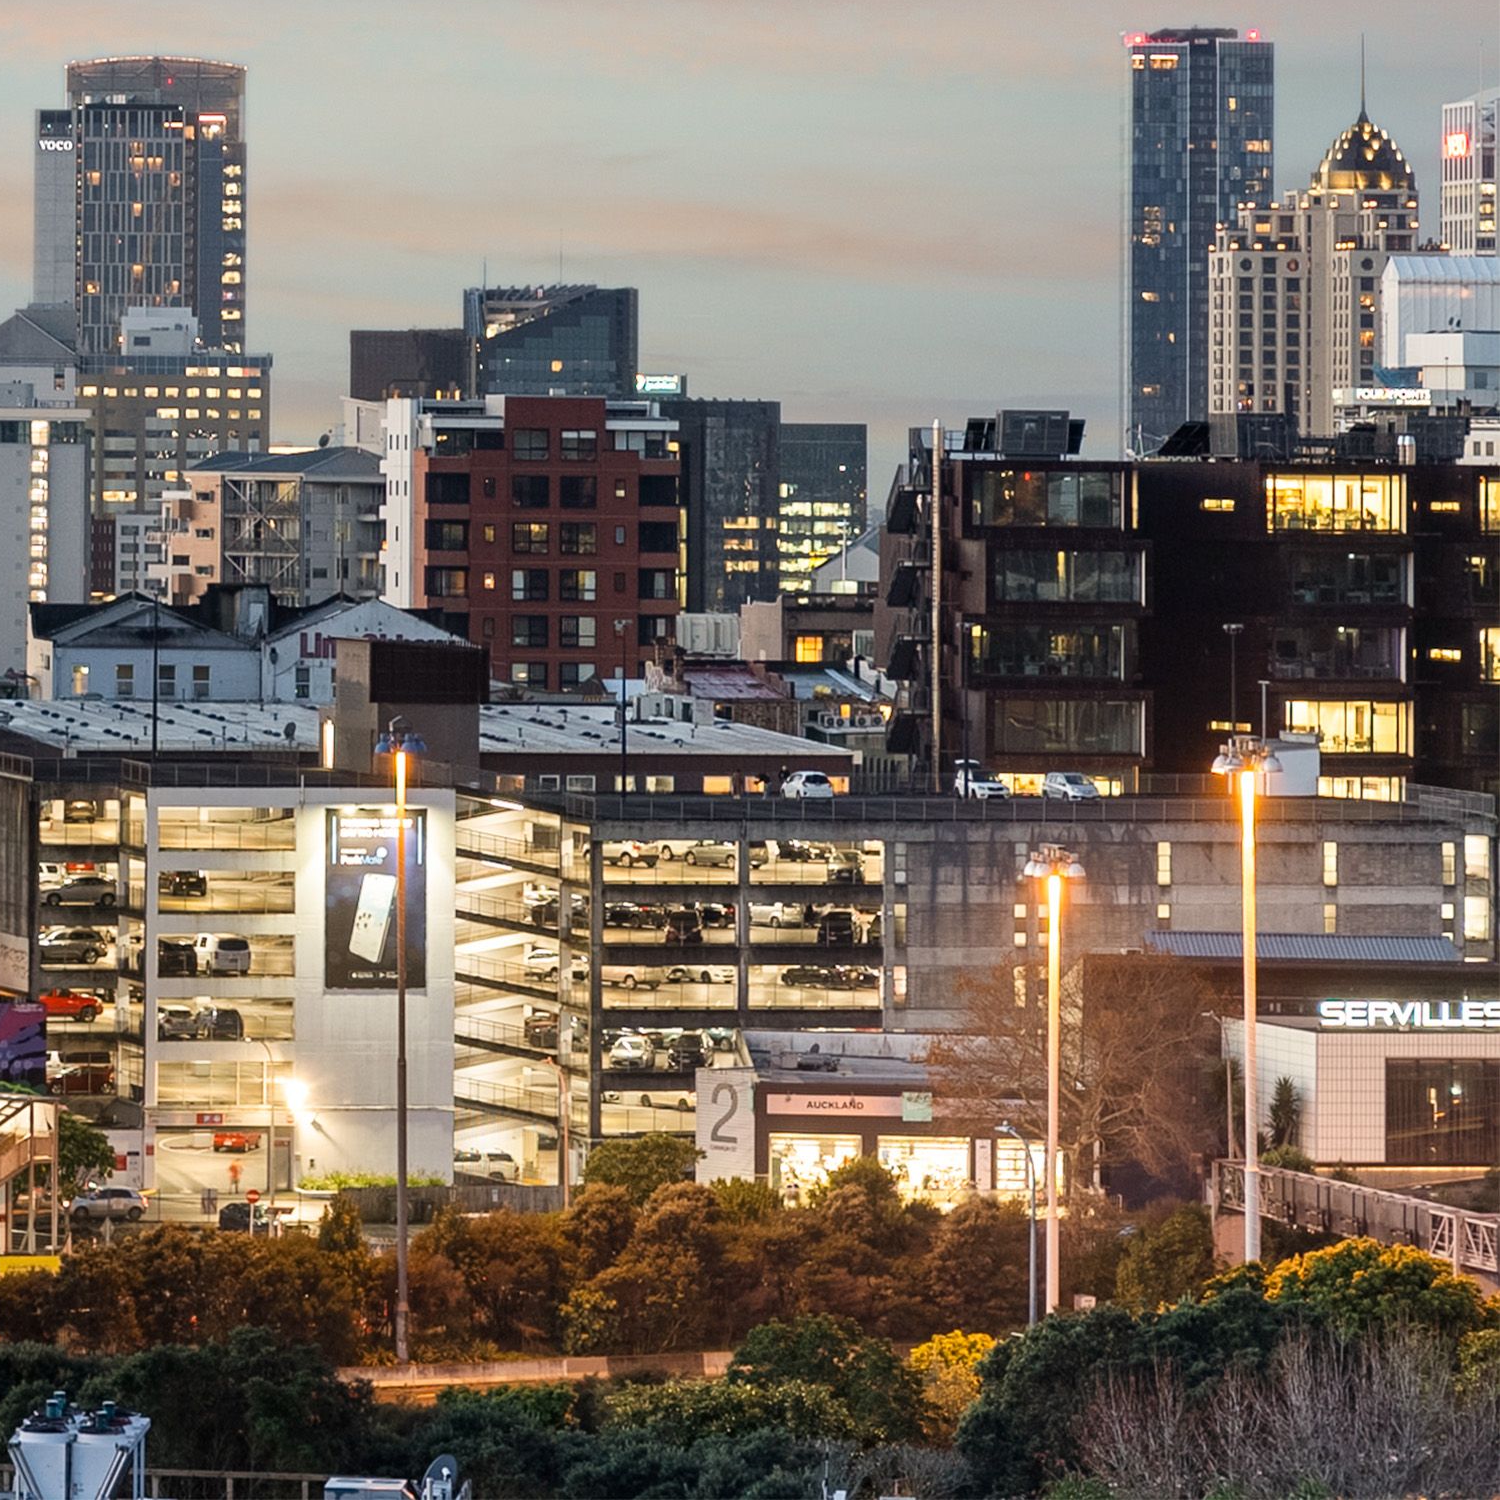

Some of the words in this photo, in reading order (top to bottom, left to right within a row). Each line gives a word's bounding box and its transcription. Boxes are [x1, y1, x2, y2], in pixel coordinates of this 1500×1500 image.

[1320, 1001, 1500, 1027] SERVILLES
[711, 1083, 739, 1144] 2
[806, 1100, 864, 1110] AUCKLAND
